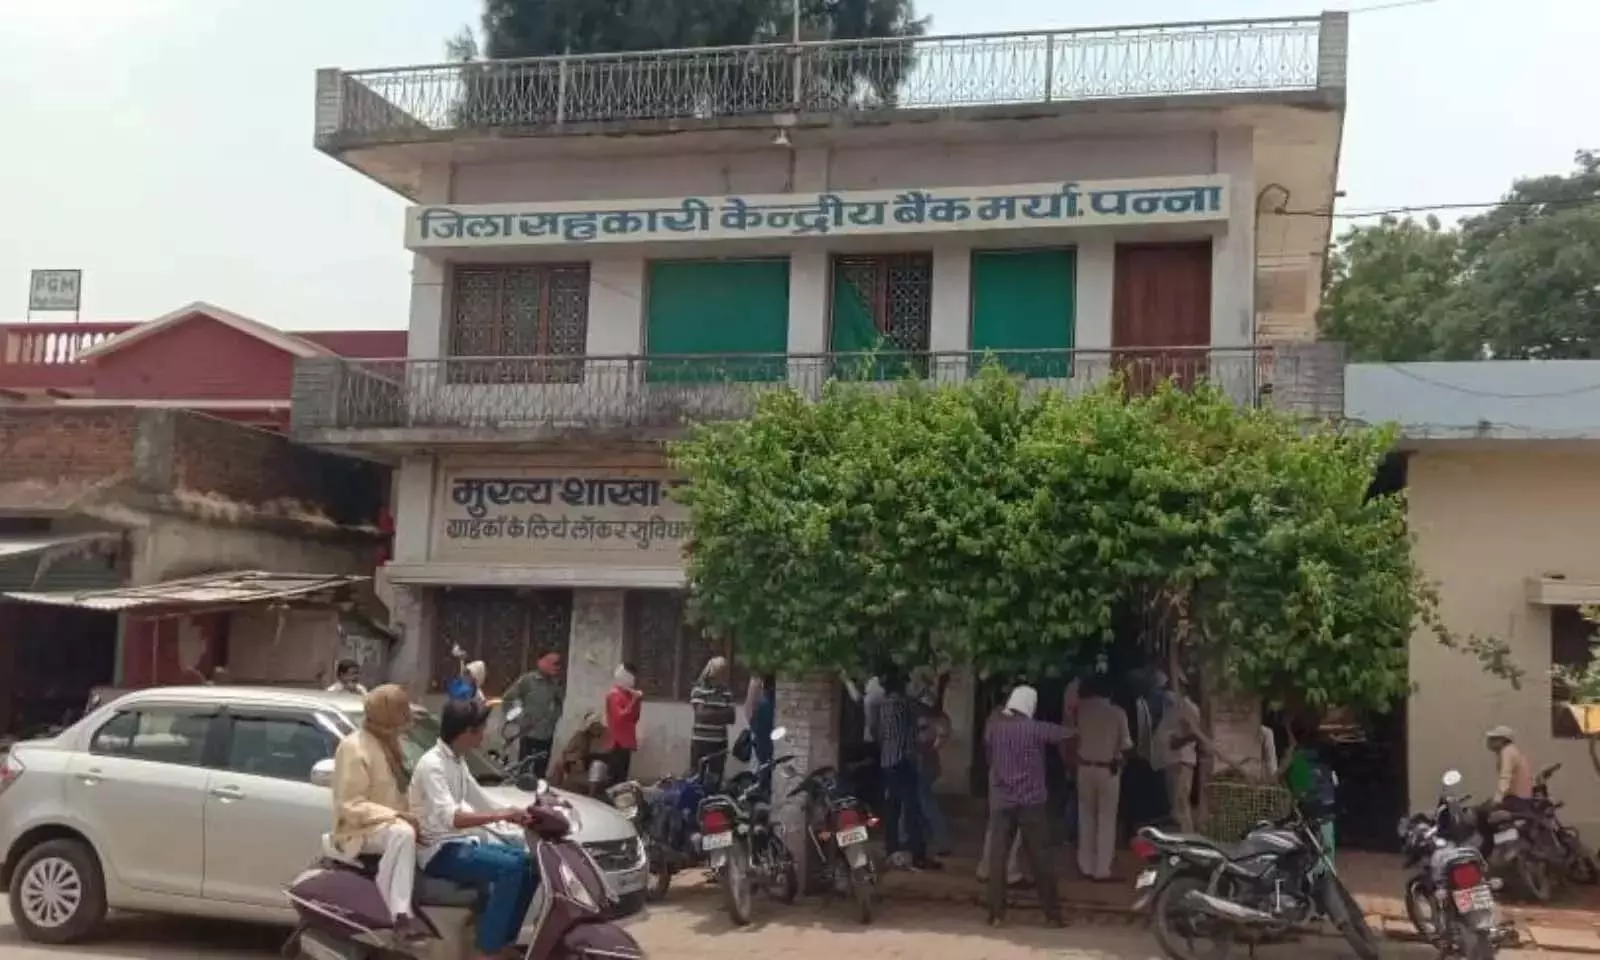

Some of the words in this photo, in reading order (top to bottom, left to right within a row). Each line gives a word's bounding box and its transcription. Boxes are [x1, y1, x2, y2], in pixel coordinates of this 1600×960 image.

[418, 208, 513, 240] जिला
[518, 198, 713, 242] सहकारी
[719, 193, 889, 234] केन्द्रीय
[892, 189, 971, 224] बैंक
[1088, 185, 1224, 217] पन्ना
[452, 477, 553, 517] मुख्य
[508, 515, 526, 538] के
[570, 515, 627, 541] लॉकर
